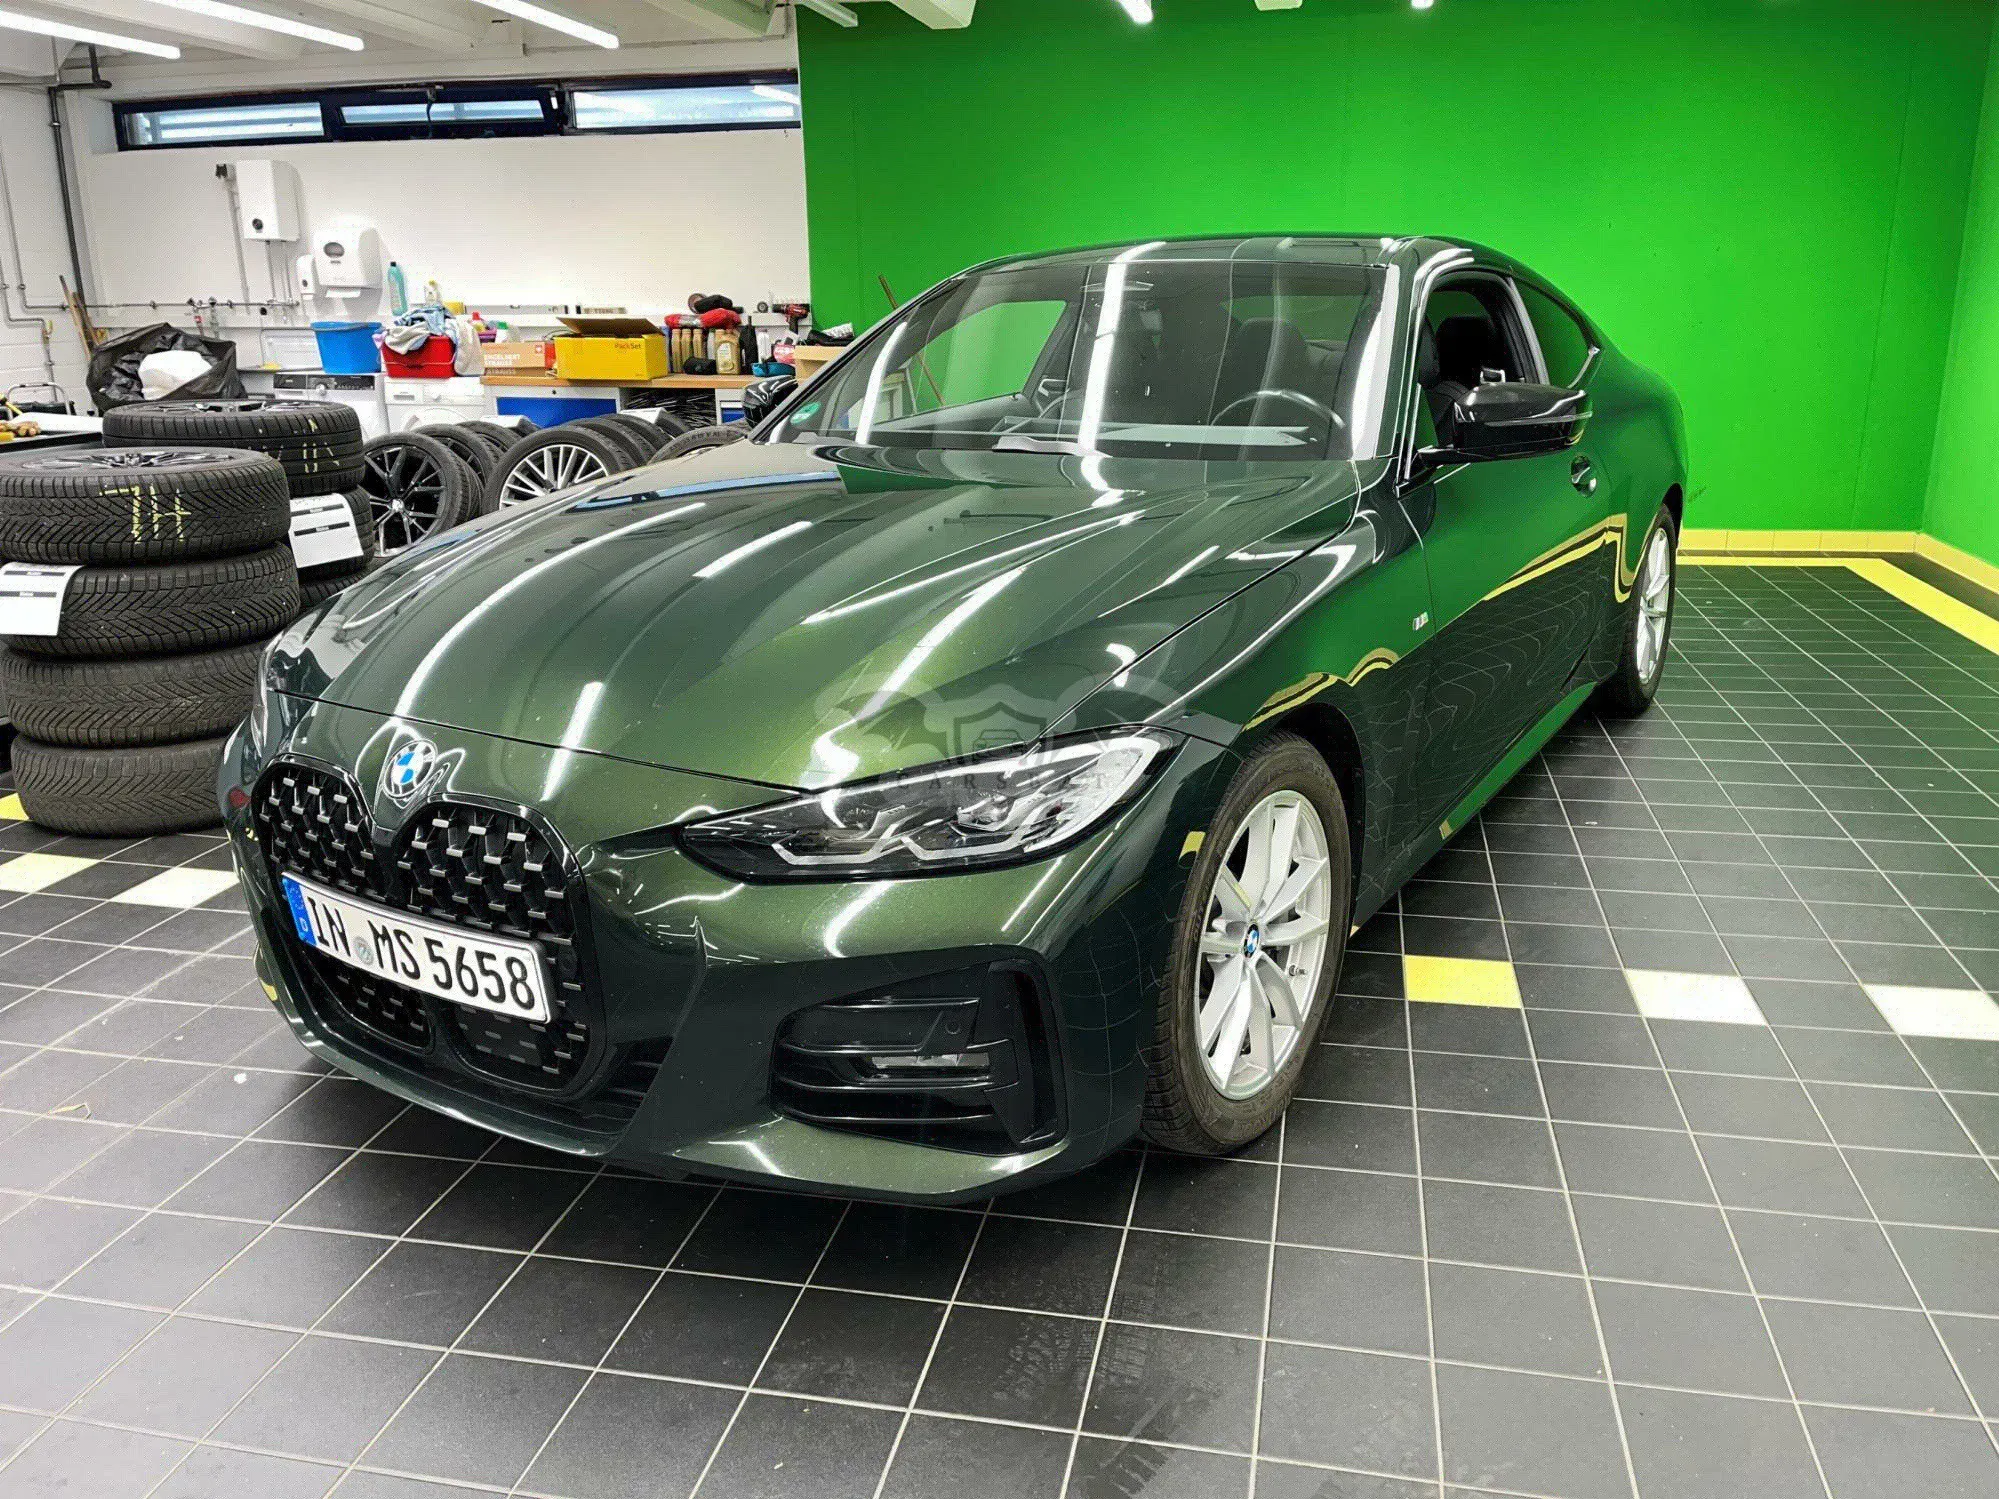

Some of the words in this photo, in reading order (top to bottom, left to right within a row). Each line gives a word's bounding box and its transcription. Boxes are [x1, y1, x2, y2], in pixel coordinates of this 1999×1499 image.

[299, 917, 309, 932] D
[307, 896, 351, 957] IN
[367, 920, 421, 980] MS
[424, 937, 535, 1010] 5658
